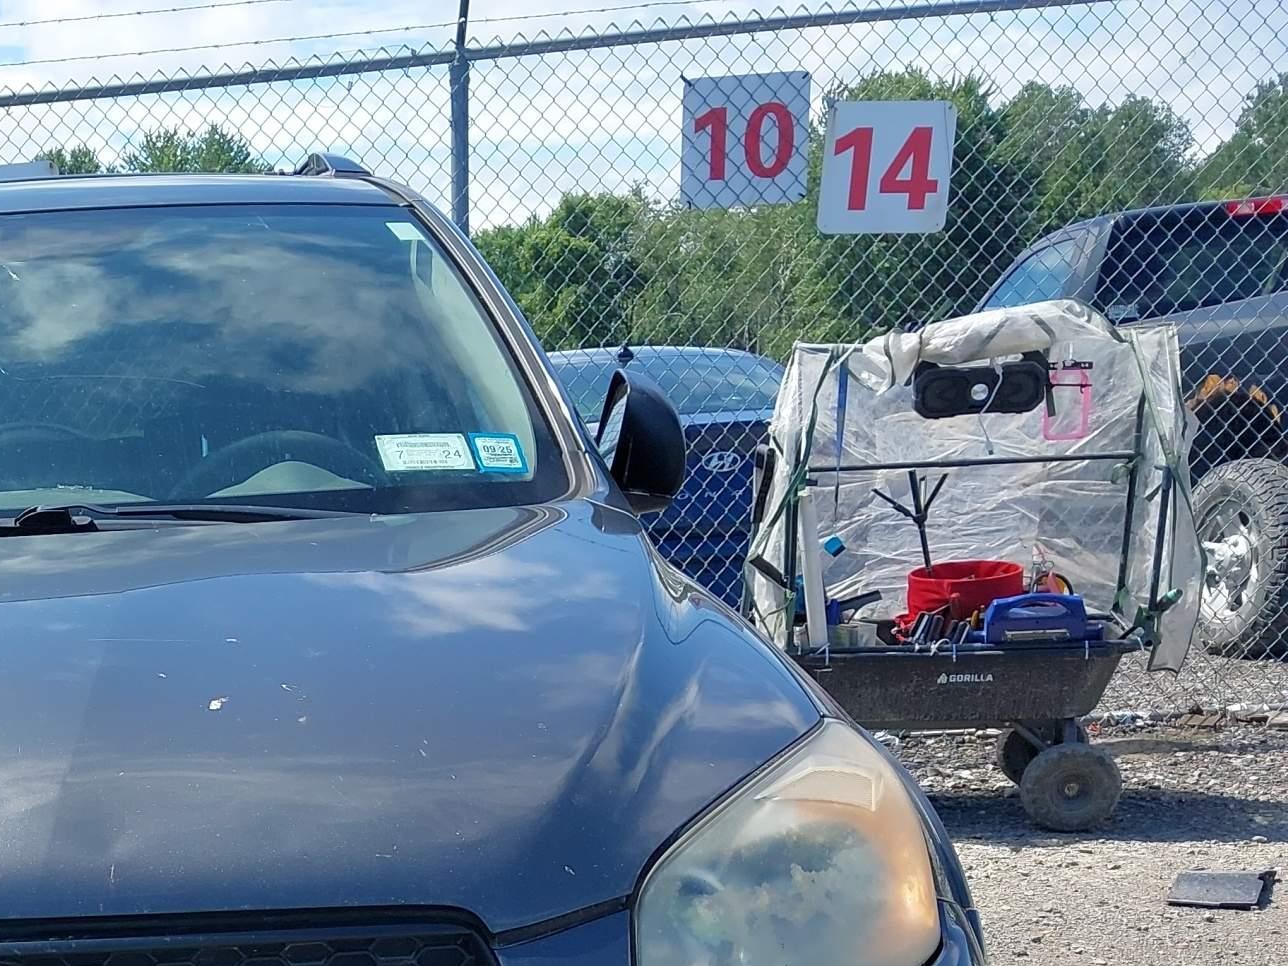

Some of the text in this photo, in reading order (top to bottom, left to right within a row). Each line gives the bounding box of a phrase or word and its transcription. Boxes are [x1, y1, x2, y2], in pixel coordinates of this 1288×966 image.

[693, 102, 795, 181] 10
[833, 127, 939, 211] 14
[442, 449, 462, 459] 24
[948, 673, 994, 683] GORILLA
